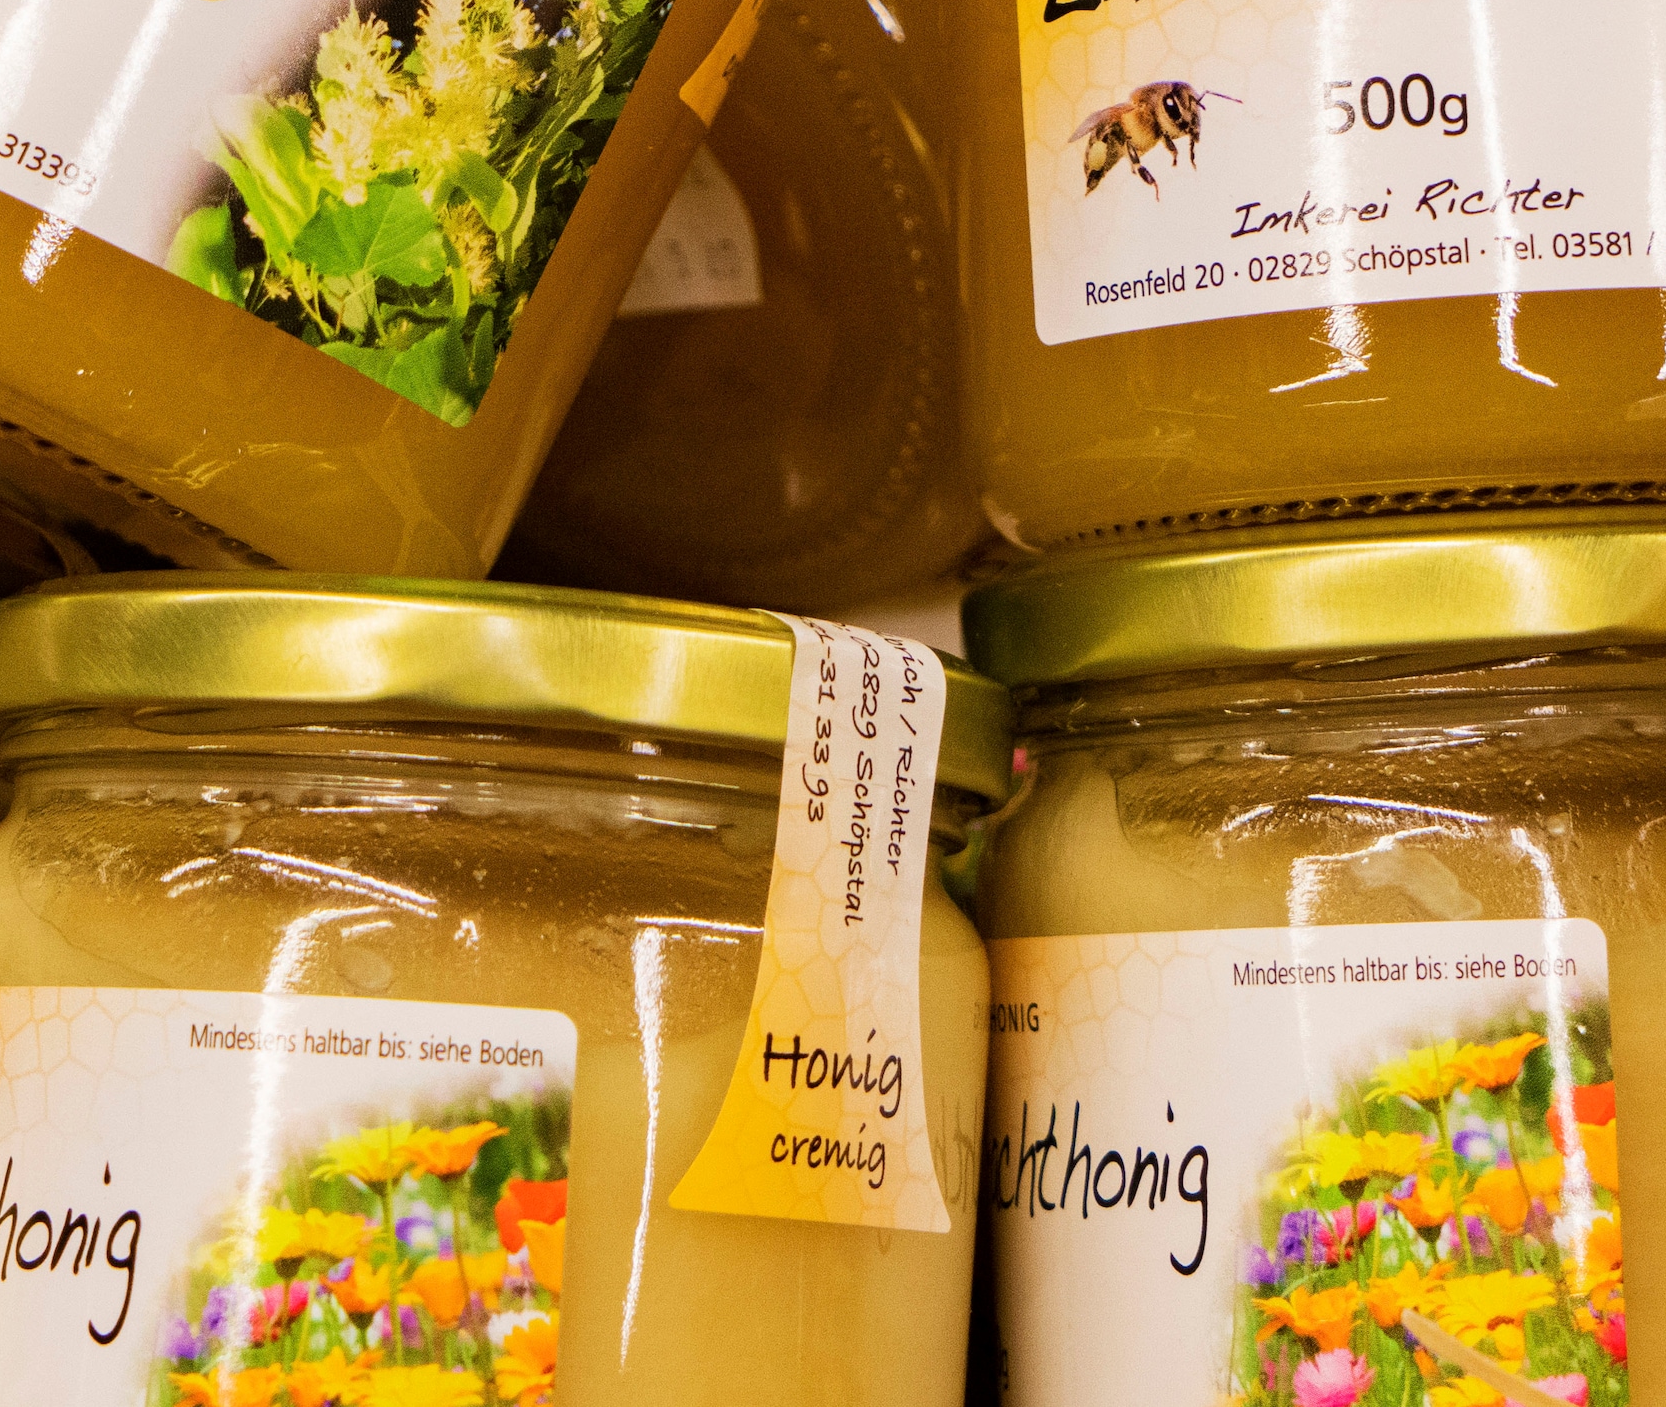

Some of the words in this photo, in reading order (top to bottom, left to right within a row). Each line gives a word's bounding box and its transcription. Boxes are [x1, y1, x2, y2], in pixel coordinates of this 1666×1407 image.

[1322, 73, 1469, 136] 500g
[1231, 187, 1392, 240] Imkerei
[1416, 178, 1585, 215] Richter
[1085, 265, 1188, 307] Rosenfeld
[1194, 262, 1225, 291] 20
[1249, 251, 1331, 285] 02829
[1342, 238, 1471, 277] Schöpstal
[1499, 232, 1544, 262] Tel.
[1552, 229, 1634, 261] 03581
[849, 635, 880, 740] 02829
[841, 750, 874, 927] Schöpstal
[887, 745, 916, 876] Richter
[1233, 960, 1336, 986] Mindestens
[1343, 957, 1408, 984] haltbar
[1416, 955, 1448, 981] bis:
[1456, 954, 1506, 979] siehe
[303, 1027, 372, 1057] haltbar
[379, 1031, 412, 1059] bis:
[419, 1035, 472, 1063] siehe
[480, 1039, 544, 1067] Boden
[764, 1029, 903, 1120] Honig
[770, 1123, 889, 1191] cremig
